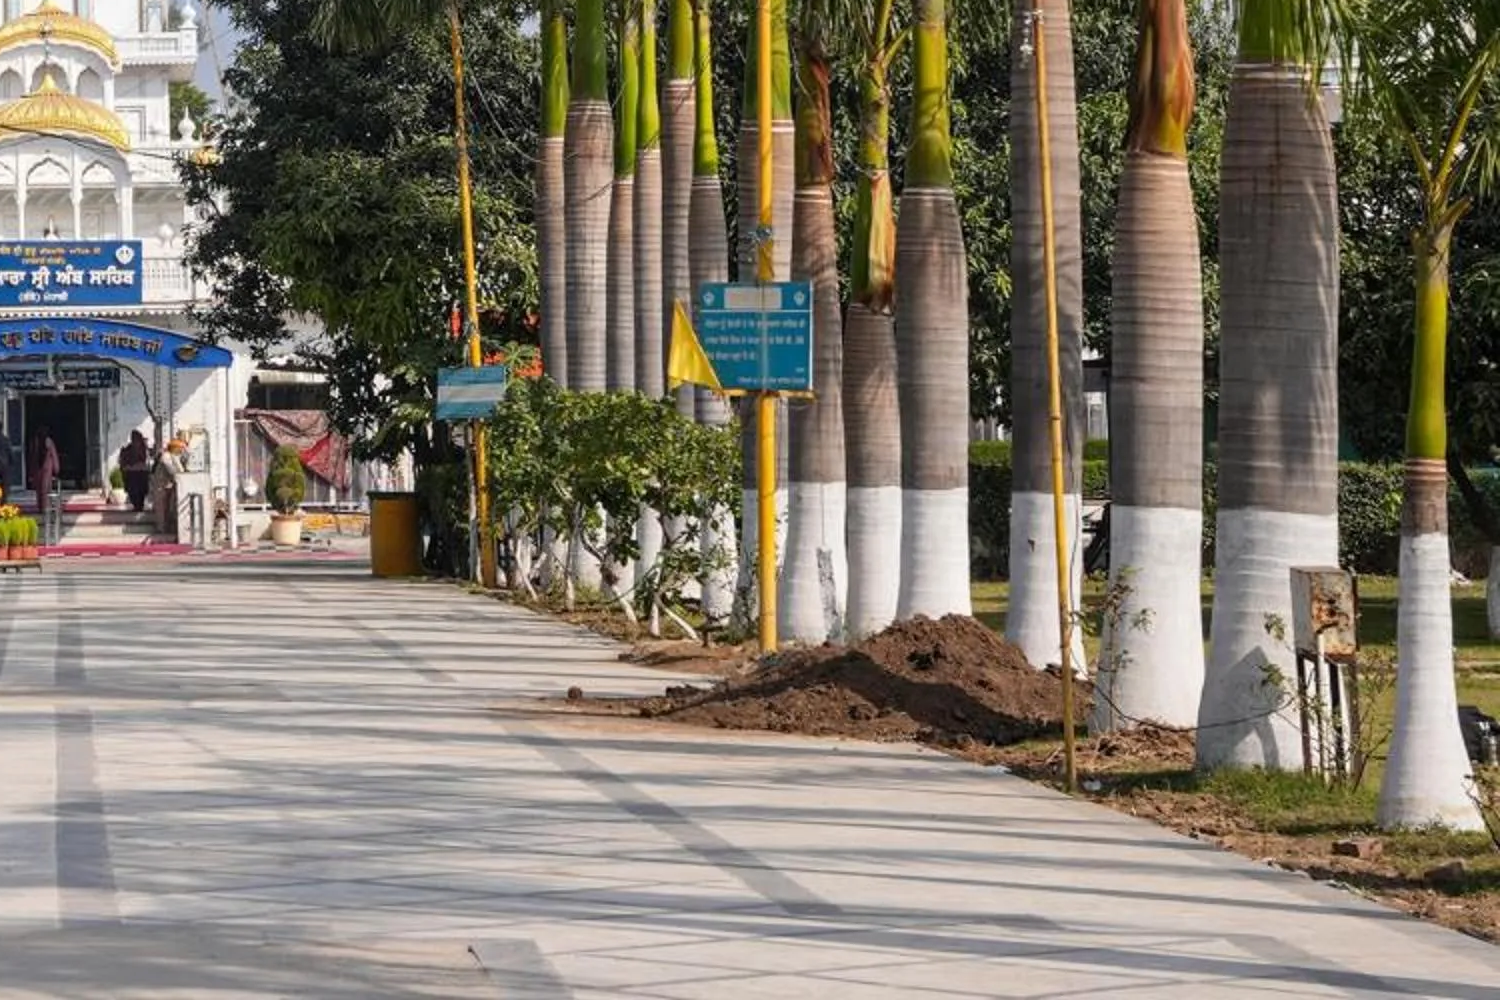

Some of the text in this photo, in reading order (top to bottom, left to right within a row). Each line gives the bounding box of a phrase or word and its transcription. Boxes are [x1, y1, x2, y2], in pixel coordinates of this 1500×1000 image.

[31, 265, 50, 291] ਸ੍ਰੀ
[56, 264, 84, 286] ਅੰਬ
[89, 265, 135, 286] ਸਾਹਿਬ
